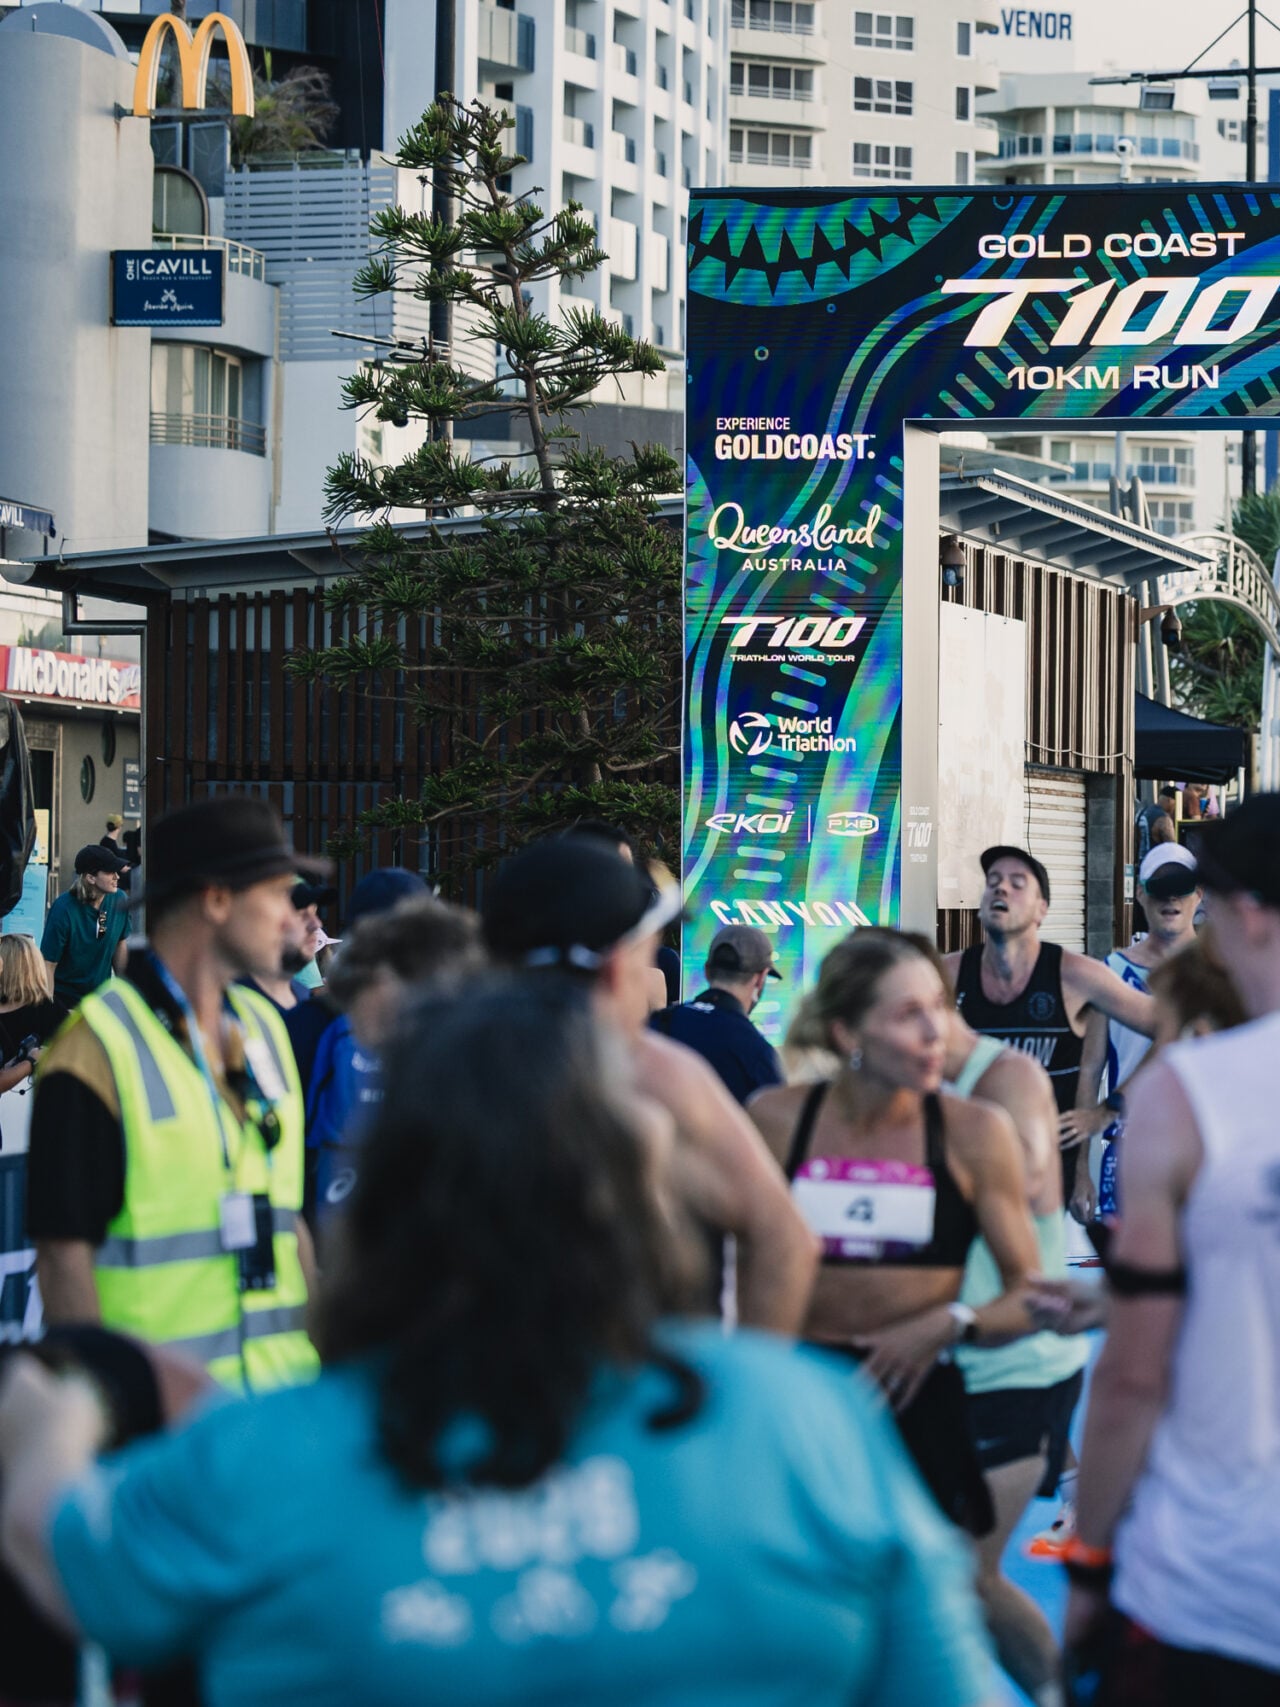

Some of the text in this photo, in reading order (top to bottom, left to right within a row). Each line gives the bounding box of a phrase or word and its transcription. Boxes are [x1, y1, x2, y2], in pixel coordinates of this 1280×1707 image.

[989, 9, 1072, 40] VENOR
[978, 232, 1246, 259] GOLD COAST
[126, 259, 135, 281] ONE
[141, 258, 213, 275] CAVILL
[1007, 364, 1220, 391] 10KM RUN
[716, 417, 791, 431] EXPERIENCE
[0, 504, 24, 527] AVILL
[708, 502, 882, 554] Queensland
[741, 558, 847, 571] AUSTRALIA
[721, 616, 867, 648] T100
[730, 654, 855, 663] TRIATHLON WORLD TOUR
[14, 646, 120, 704] McDonald's
[778, 716, 832, 734] World
[778, 734, 857, 753] Triathlon
[710, 900, 873, 926] CANYON
